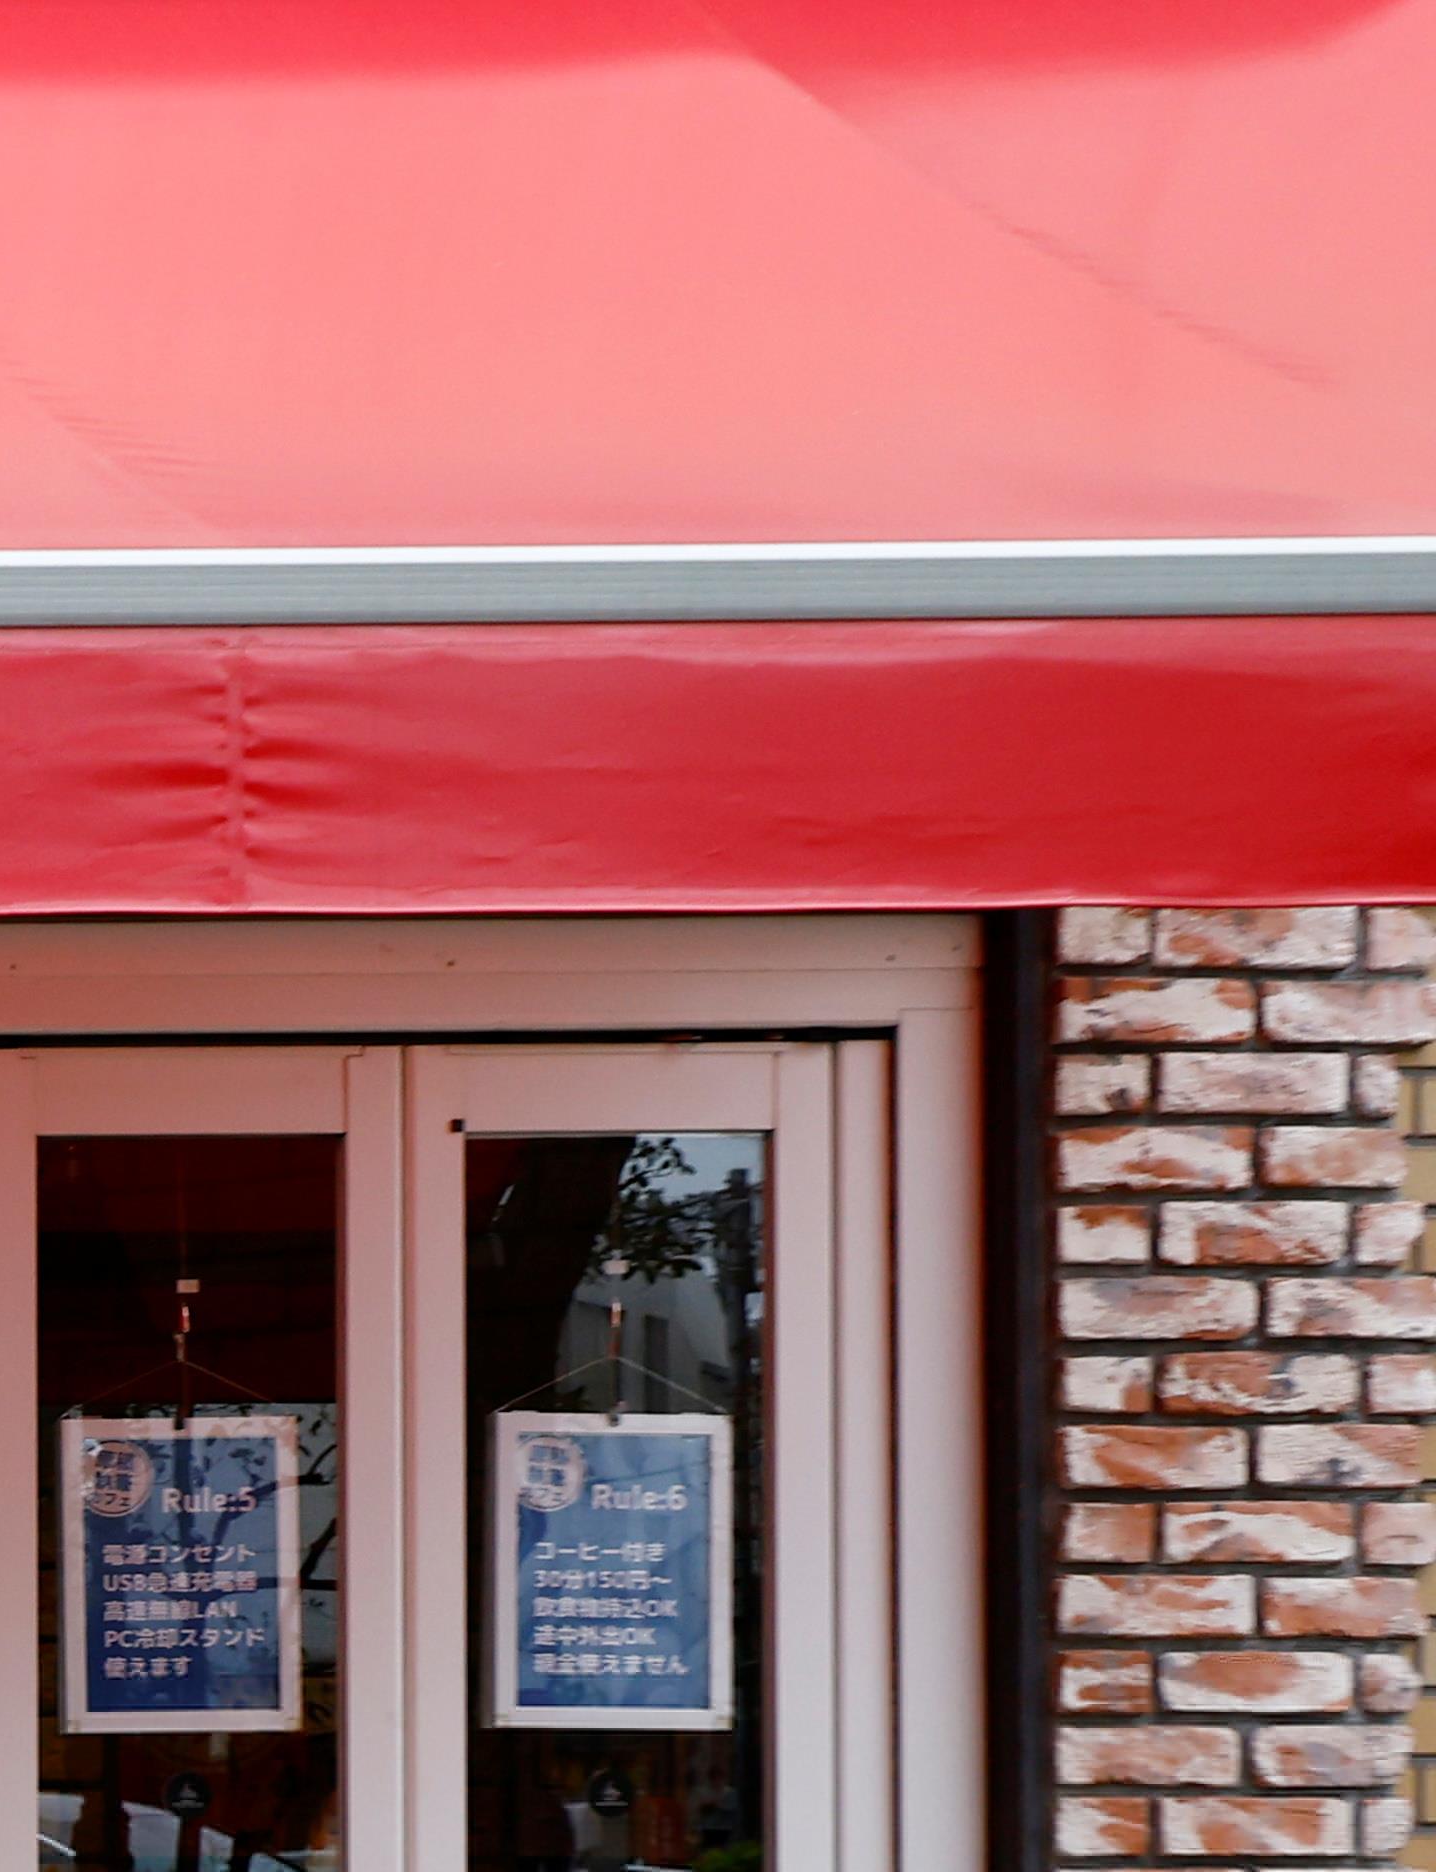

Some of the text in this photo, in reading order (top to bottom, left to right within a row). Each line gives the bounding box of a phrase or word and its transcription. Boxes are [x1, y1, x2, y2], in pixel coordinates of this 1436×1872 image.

[161, 1486, 258, 1513] Rule:5
[591, 1483, 689, 1511] Rule:6
[102, 1543, 256, 1565] 電源コンセント
[534, 1541, 667, 1562] コーヒー付き
